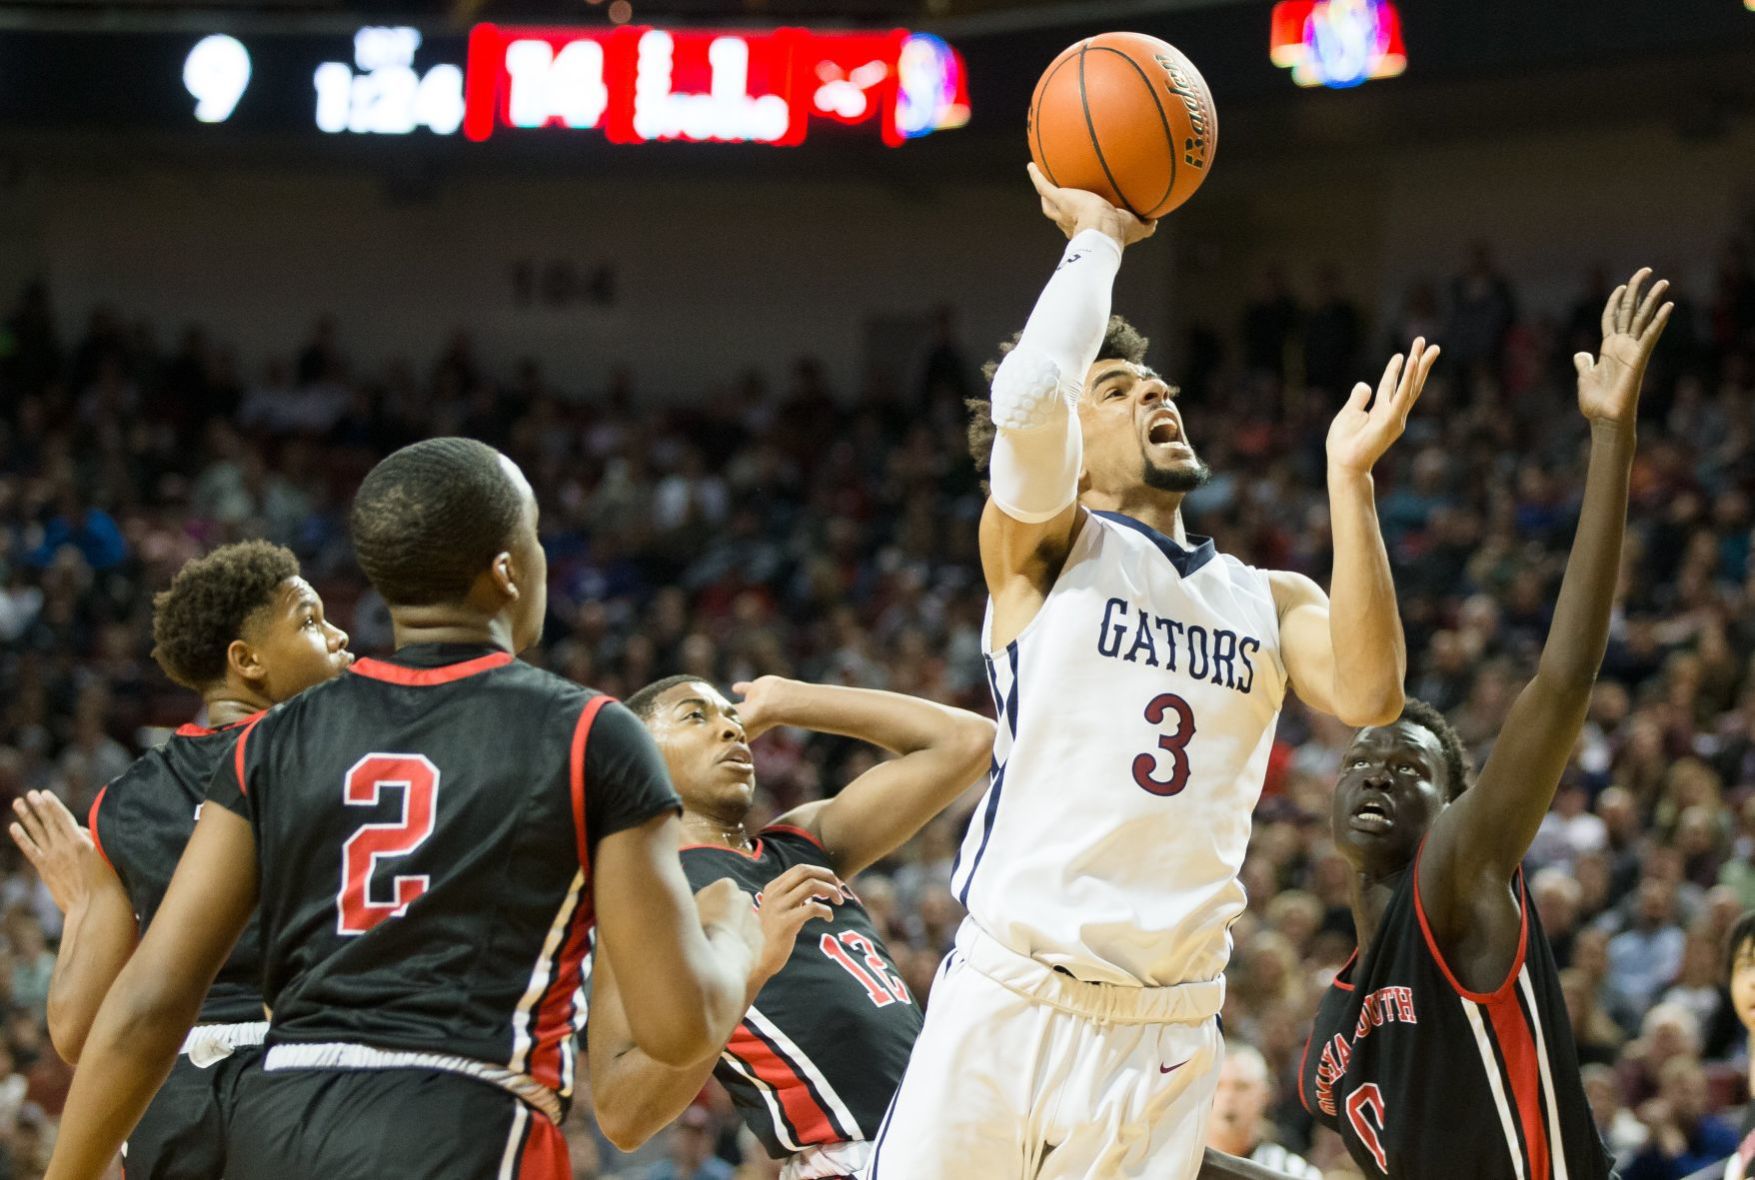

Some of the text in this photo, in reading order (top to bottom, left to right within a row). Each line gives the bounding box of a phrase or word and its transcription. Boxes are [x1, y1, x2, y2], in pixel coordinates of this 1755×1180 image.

[183, 33, 252, 123] 9
[1153, 53, 1205, 170] Baden
[1098, 597, 1260, 694] GATORS
[1132, 692, 1197, 797] 3
[336, 752, 441, 936] 2
[819, 929, 912, 1008] 12
